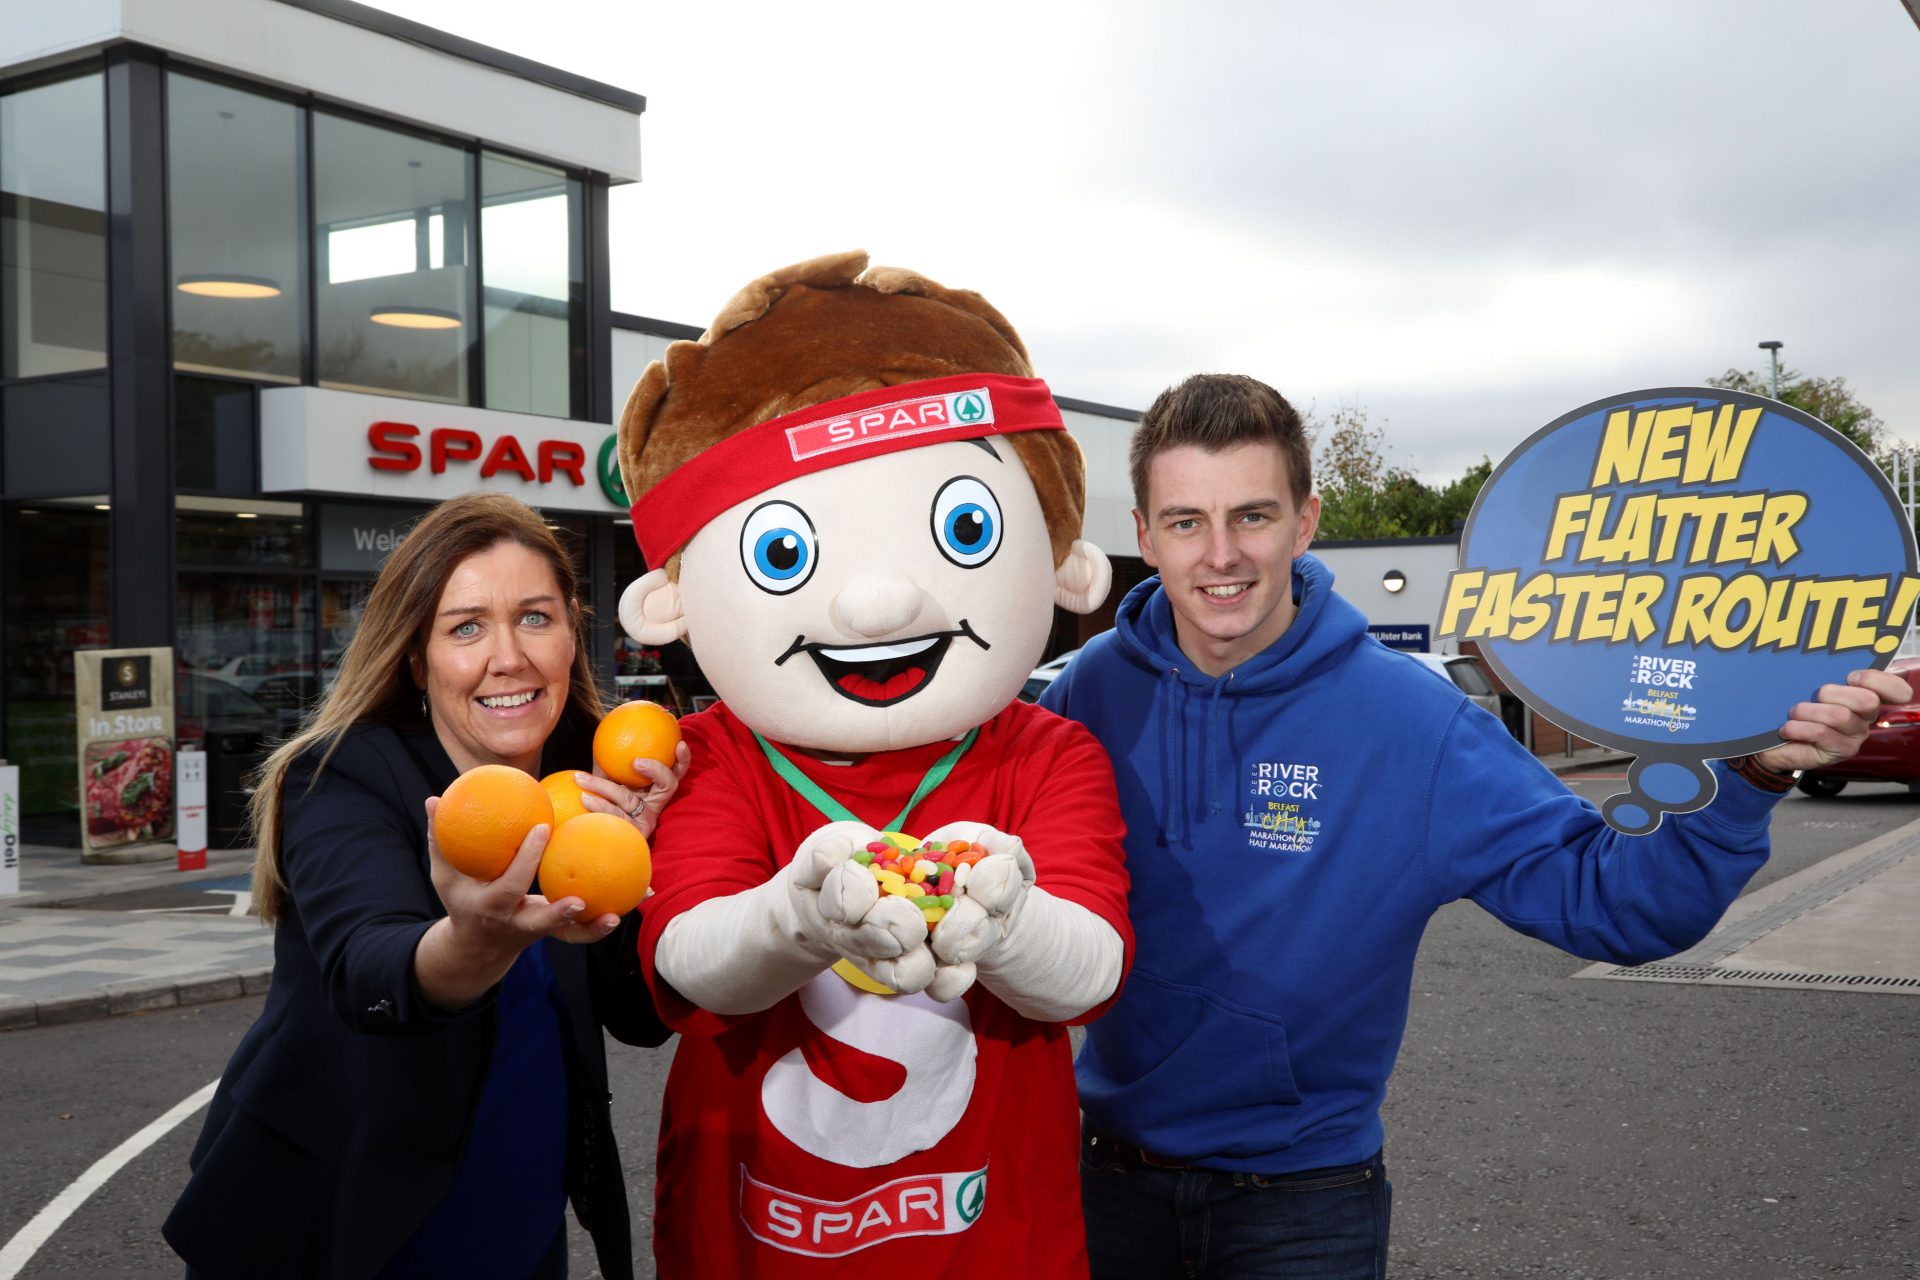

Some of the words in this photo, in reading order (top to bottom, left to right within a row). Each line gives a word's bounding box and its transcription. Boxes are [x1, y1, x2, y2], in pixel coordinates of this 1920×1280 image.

[827, 403, 946, 442] SPAR
[368, 421, 585, 486] SPAR
[1592, 404, 1763, 487] NEW
[1544, 493, 1808, 565] FLATTER
[1439, 571, 1665, 643] FASTER
[1668, 573, 1920, 654] ROUTE!
[1376, 631, 1401, 640] Ulster
[1401, 631, 1423, 640] Bank
[1640, 656, 1697, 674] RIVER
[1637, 670, 1695, 689] ROCK
[1647, 688, 1679, 699] BELFAST
[89, 718, 109, 736] In
[114, 715, 163, 734] Store
[1624, 716, 1670, 728] MARATHON
[1672, 721, 1690, 730] 2019
[1258, 763, 1319, 781] RIVER
[1257, 779, 1318, 800] ROCK
[1268, 801, 1300, 812] BELFAST
[1248, 838, 1268, 848] HALF
[1269, 841, 1312, 853] MARATHON
[1250, 830, 1296, 842] MARATHON
[1296, 836, 1314, 844] AND
[768, 1187, 939, 1243] SPAR
